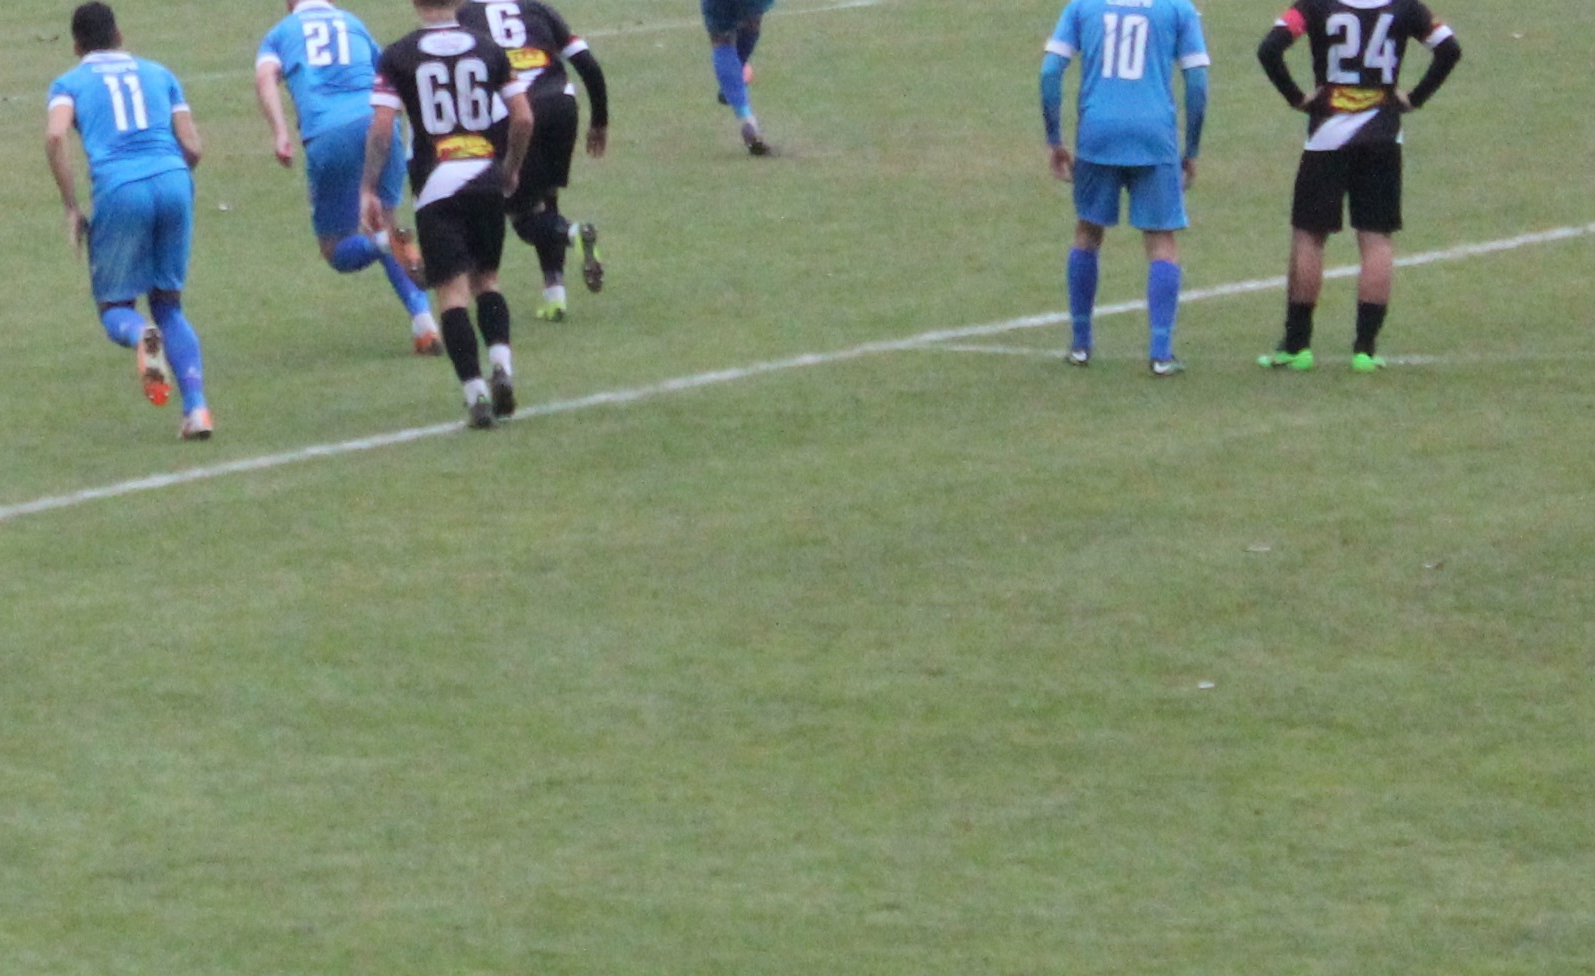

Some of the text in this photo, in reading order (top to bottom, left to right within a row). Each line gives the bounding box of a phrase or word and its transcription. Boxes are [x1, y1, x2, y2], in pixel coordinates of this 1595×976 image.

[302, 20, 350, 66] 21
[485, 2, 527, 48] 6
[1102, 12, 1149, 80] 10
[1325, 12, 1397, 84] 24
[103, 75, 149, 131] 11
[415, 58, 492, 135] 66
